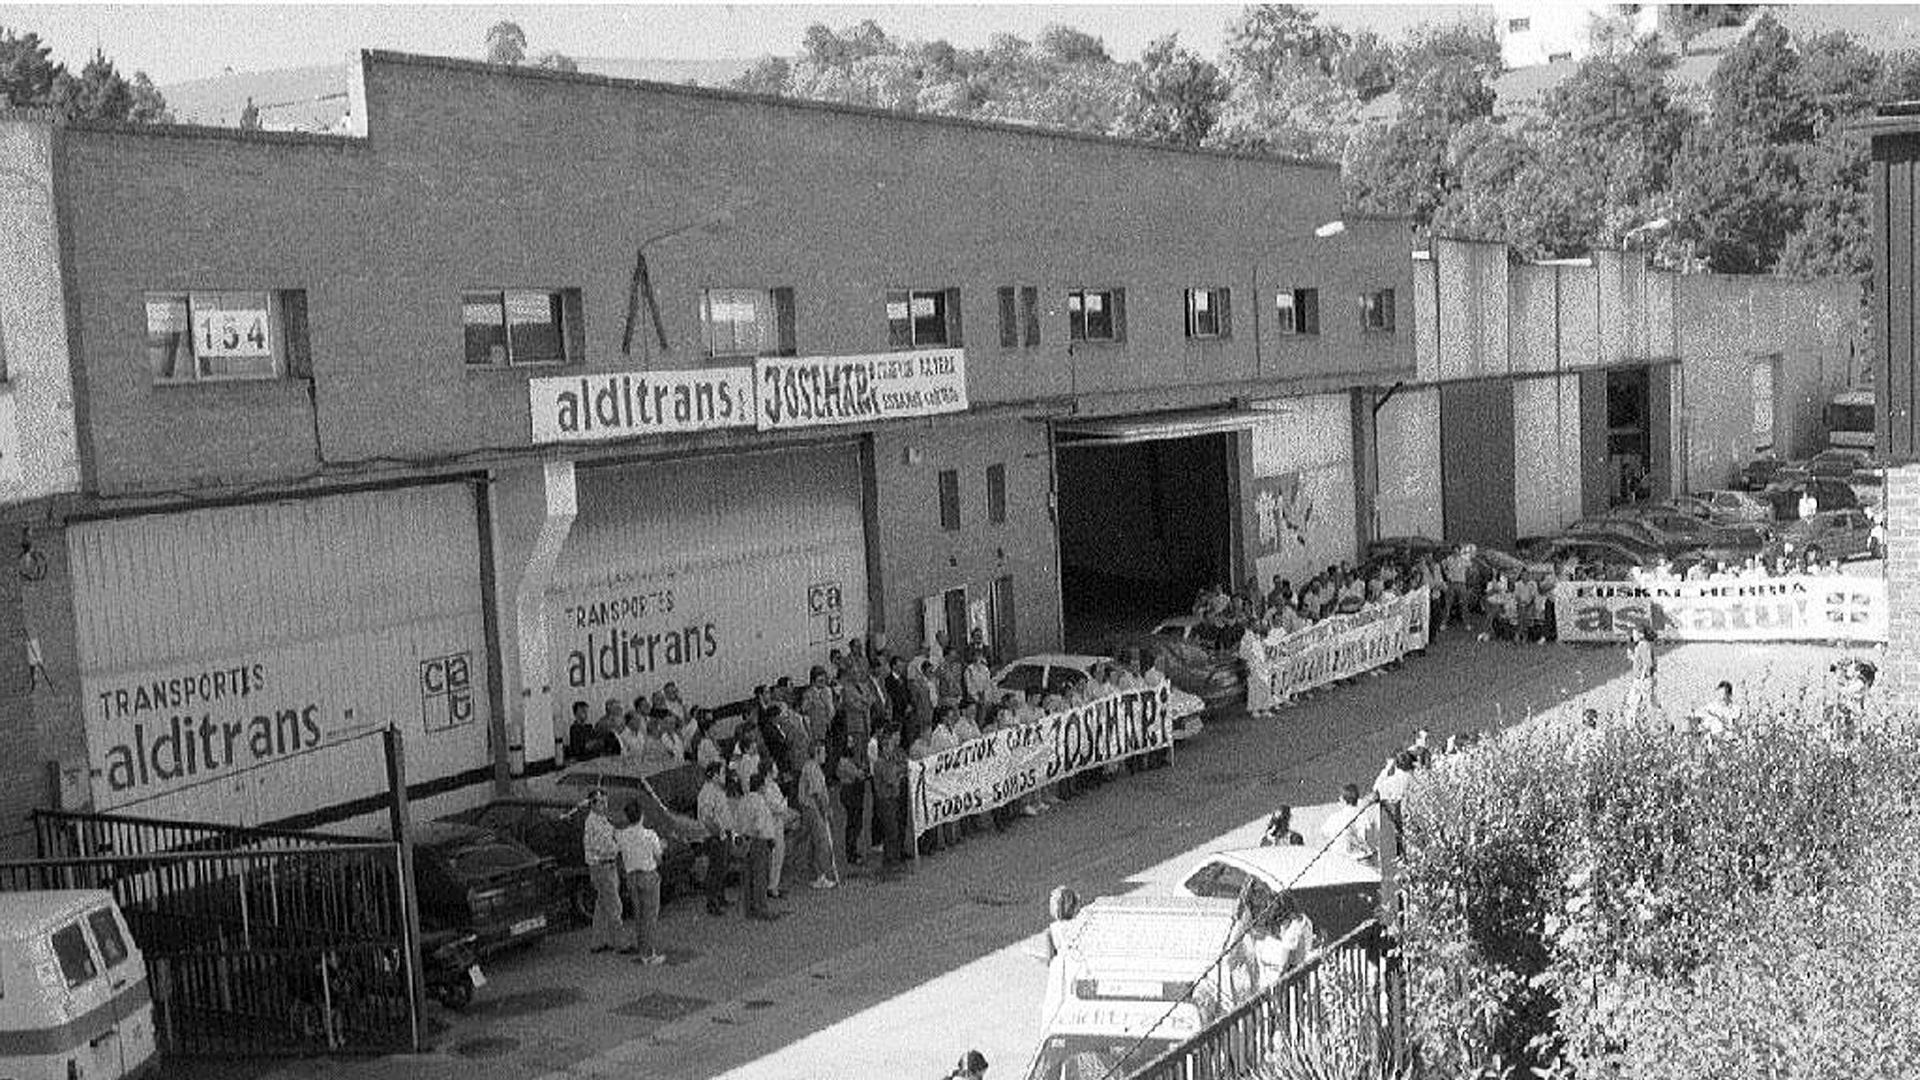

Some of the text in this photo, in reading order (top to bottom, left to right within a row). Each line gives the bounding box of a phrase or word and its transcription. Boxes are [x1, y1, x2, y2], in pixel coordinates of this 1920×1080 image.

[556, 374, 733, 434] alditrans
[565, 590, 674, 629] TRANSPORTES
[568, 623, 717, 687] alditrans
[100, 664, 265, 720] TRANSPORTES
[105, 703, 322, 792] alditrans
[932, 769, 1036, 822] TODOS SOMOS
